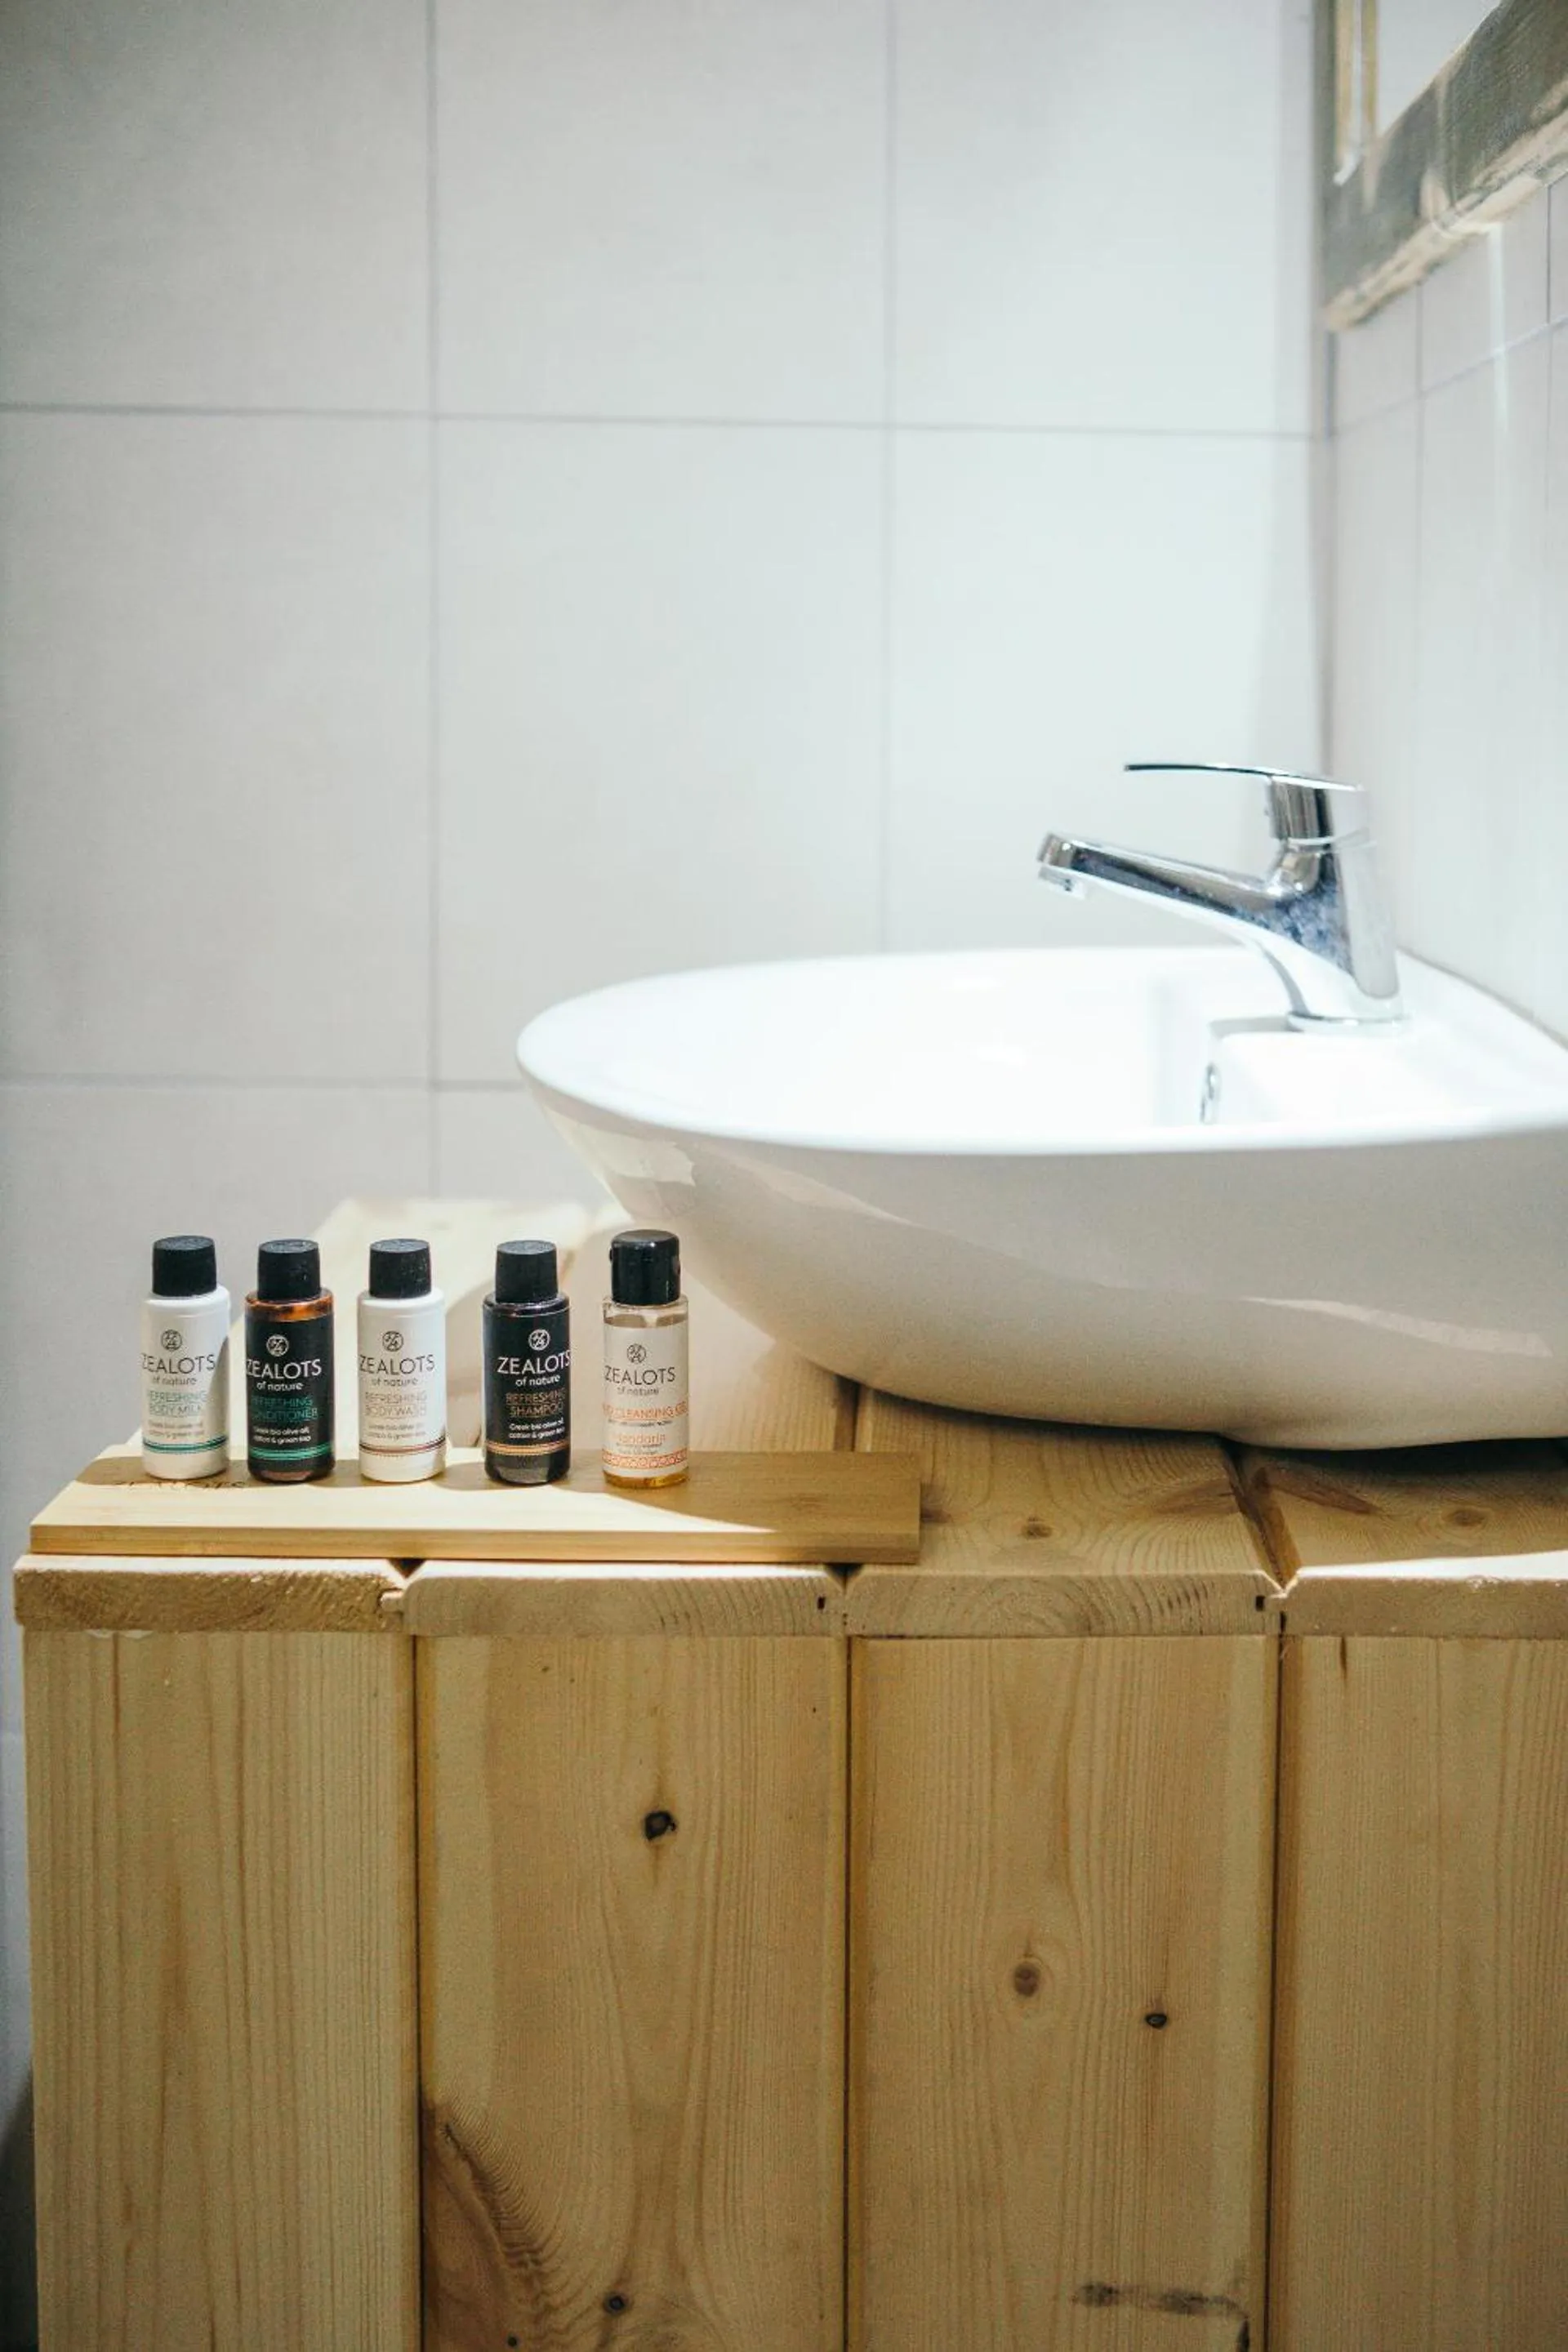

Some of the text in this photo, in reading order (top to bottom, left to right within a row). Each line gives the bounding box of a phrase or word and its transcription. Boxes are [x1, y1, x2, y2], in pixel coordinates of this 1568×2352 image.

[141, 1352, 216, 1375] ZEALOTS
[246, 1358, 323, 1379] ZEALOTS
[359, 1353, 435, 1375] ZEALOTS
[497, 1348, 572, 1375] ZEALOTS
[161, 1378, 197, 1388] nature
[372, 1376, 419, 1387] of nature
[515, 1374, 560, 1387] of nature
[604, 1365, 676, 1386] ZEALOTS
[256, 1381, 304, 1392] of nature
[626, 1388, 659, 1396] nature
